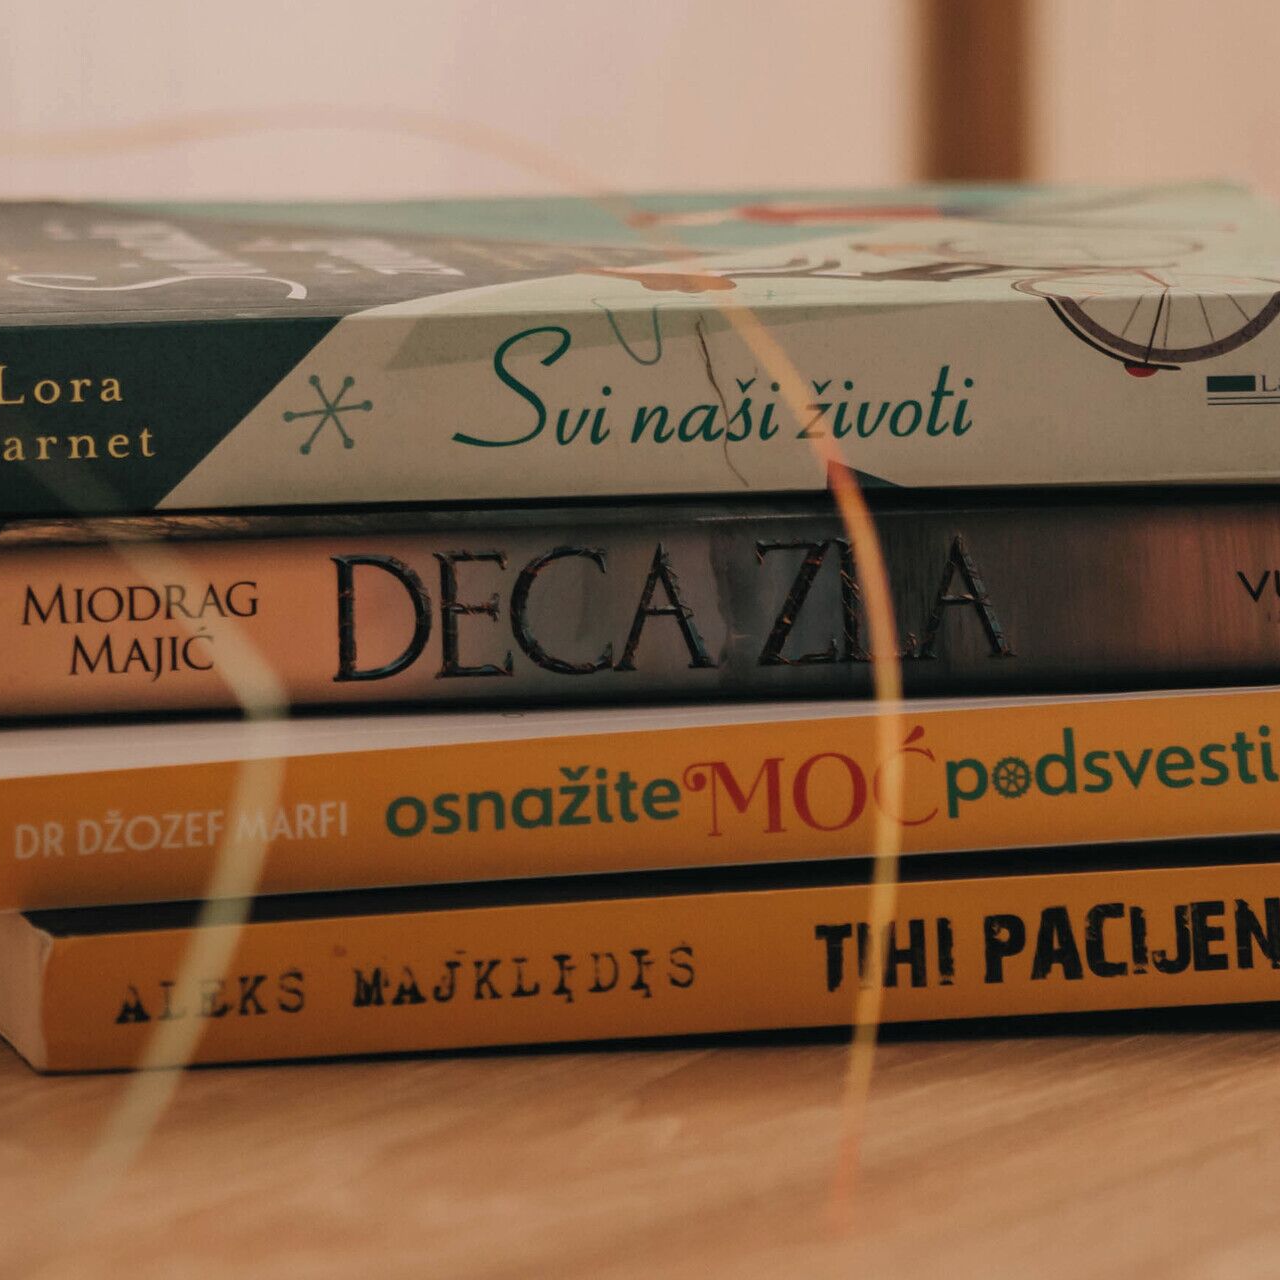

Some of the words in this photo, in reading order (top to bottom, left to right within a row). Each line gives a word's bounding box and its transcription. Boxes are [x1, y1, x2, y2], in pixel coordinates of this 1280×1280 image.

[450, 325, 613, 448] Svi
[630, 376, 780, 444] naši
[796, 364, 975, 440] životi
[21, 580, 259, 626] MIODRAG
[329, 541, 720, 683] DECA
[755, 533, 1018, 666] ZLA
[68, 626, 215, 683] MAJIĆ
[384, 765, 682, 838] osnažite
[683, 725, 940, 837] MOĆ
[945, 724, 1280, 819] podsvesti
[14, 821, 65, 861] DR
[77, 809, 225, 857] DŽOZEF
[236, 800, 349, 842] MARFI
[114, 967, 306, 1025] ALEKS
